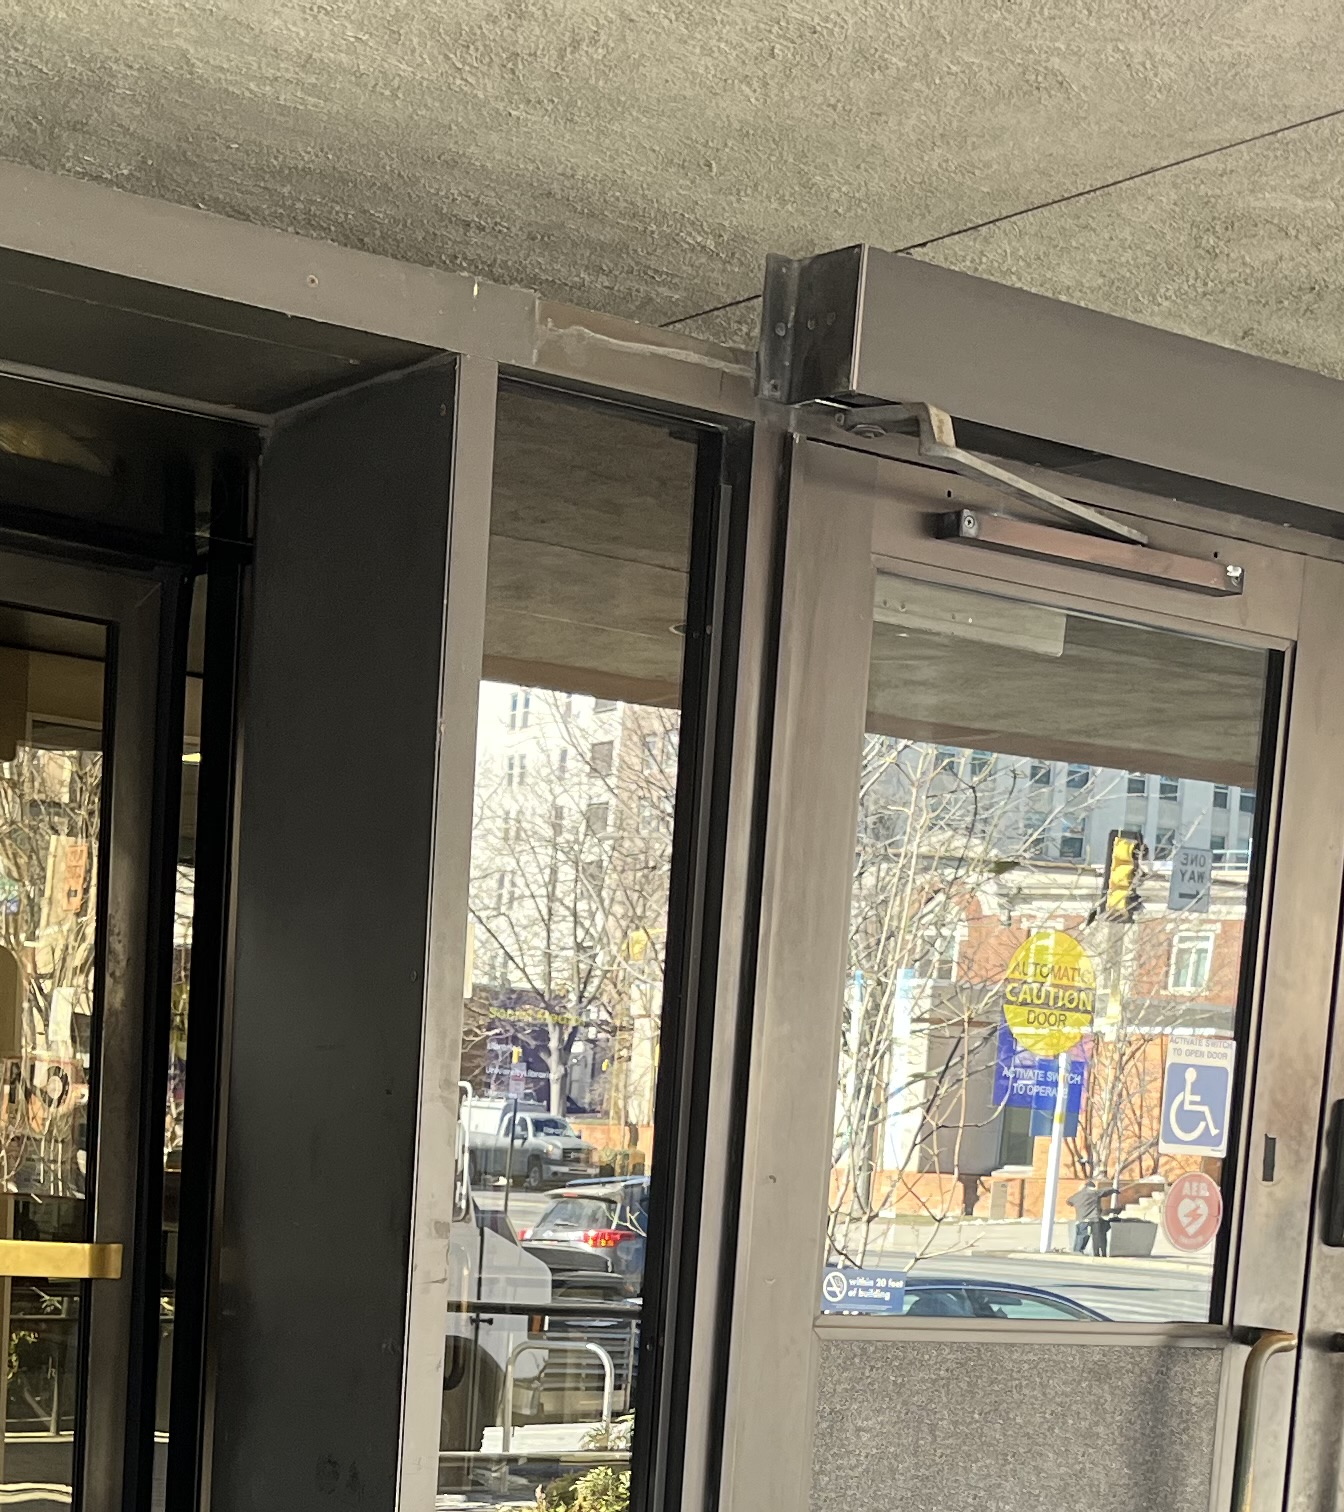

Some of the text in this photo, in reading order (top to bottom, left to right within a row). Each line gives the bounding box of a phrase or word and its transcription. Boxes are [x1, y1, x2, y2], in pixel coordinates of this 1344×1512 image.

[1010, 960, 1094, 984] AUTOMATIC
[1005, 982, 1093, 1011] CAUTION
[1026, 1009, 1067, 1027] DOOR
[1170, 1036, 1233, 1050] ACTIVATE SWITCH
[1172, 1047, 1228, 1060] TO OPEN DOOR
[1002, 1066, 1044, 1081] ACTIVATE
[1013, 1082, 1068, 1098] TO OPERAE
[849, 1277, 904, 1289] within 20 feet
[847, 1288, 891, 1302] of building
